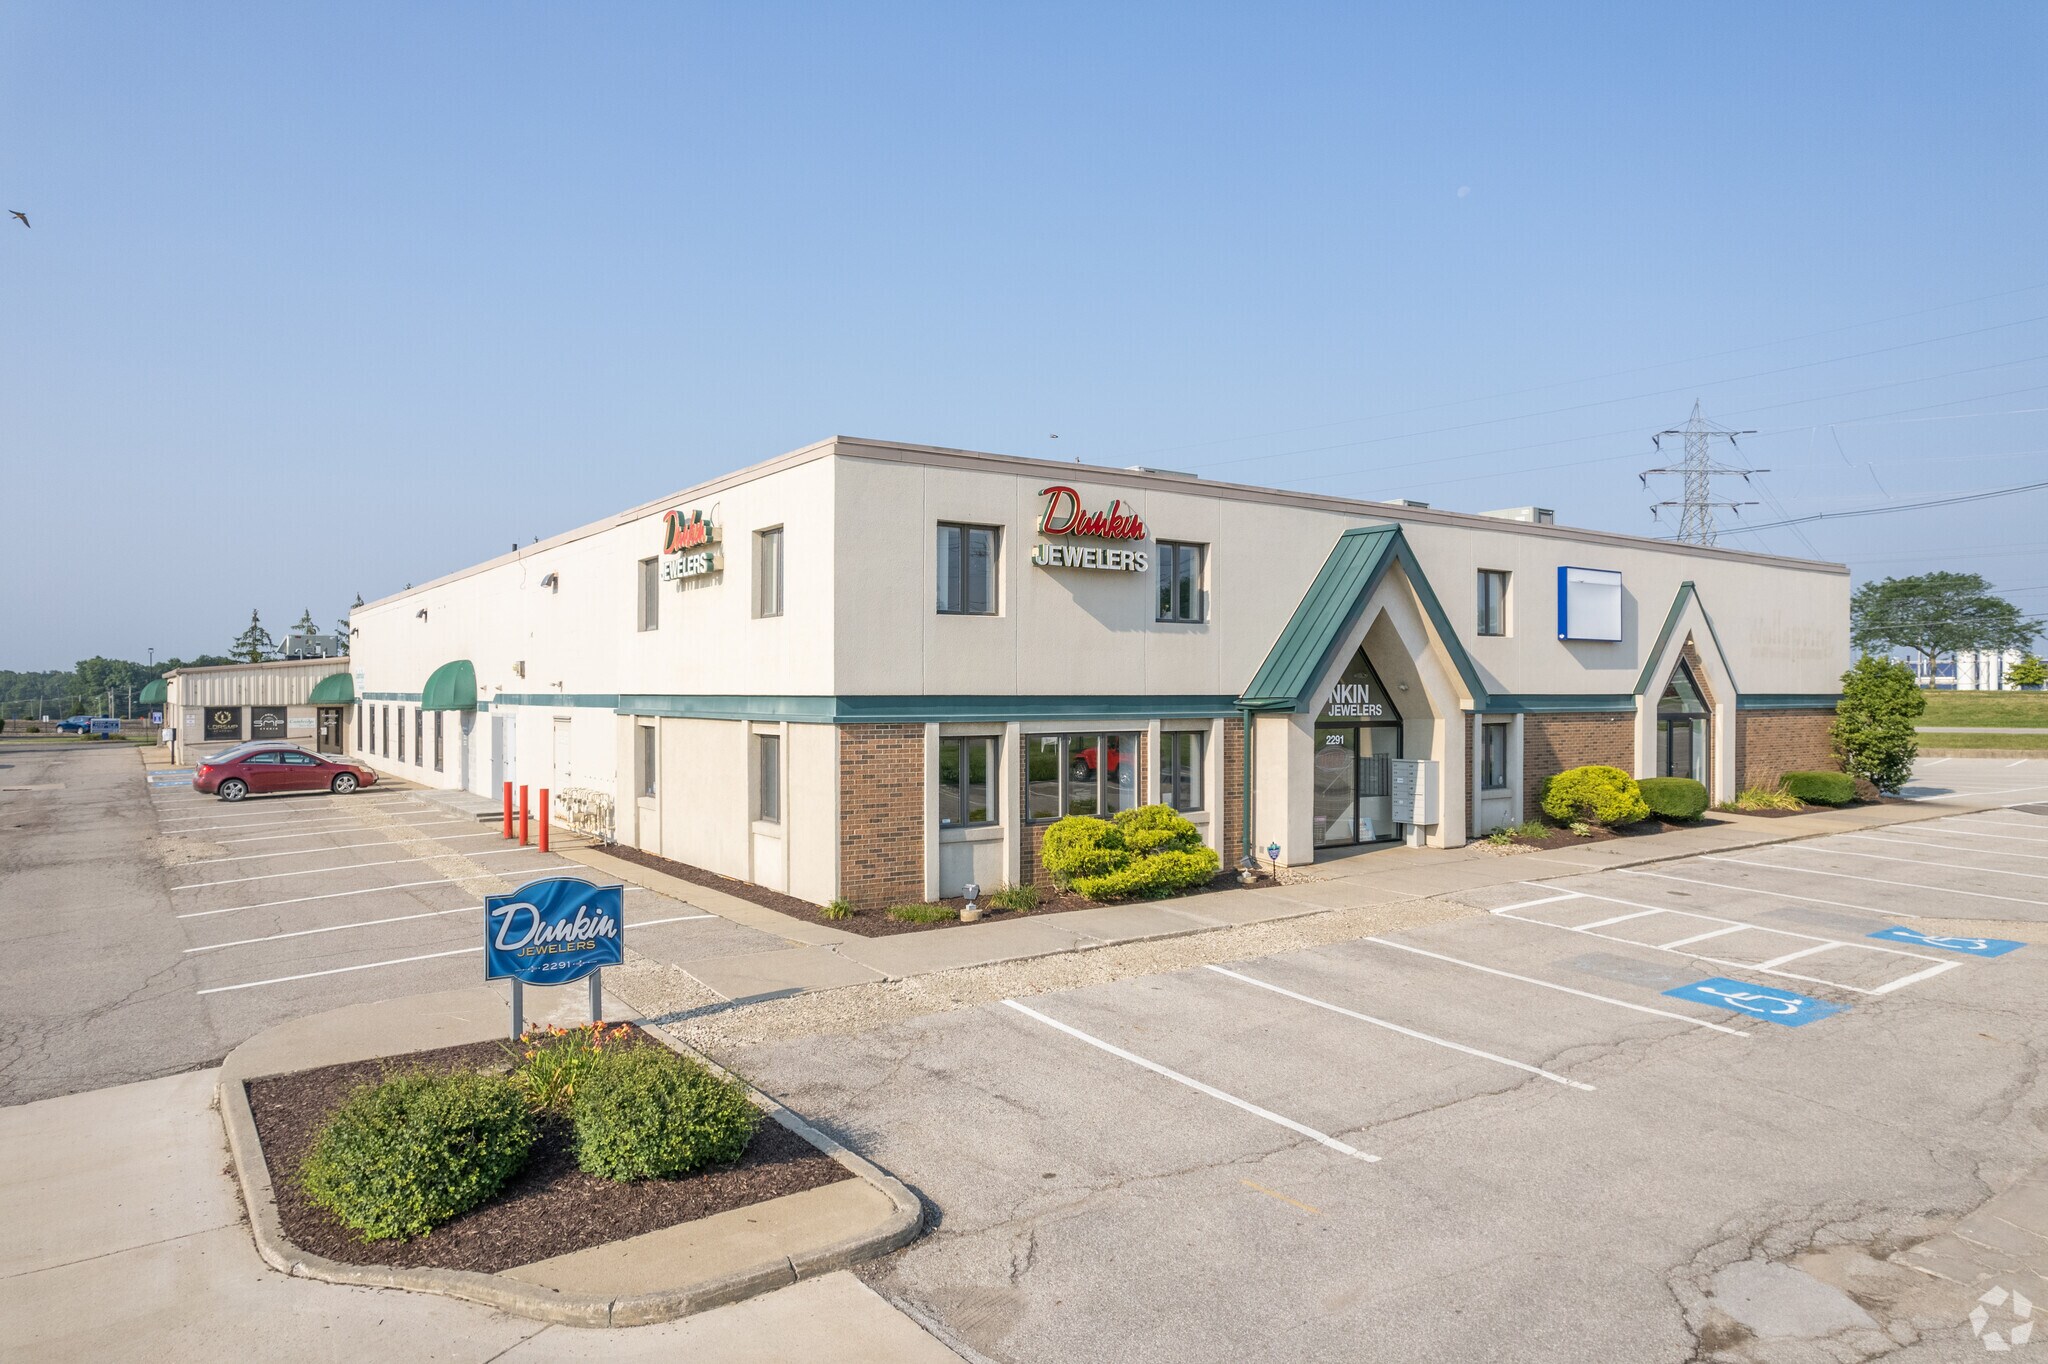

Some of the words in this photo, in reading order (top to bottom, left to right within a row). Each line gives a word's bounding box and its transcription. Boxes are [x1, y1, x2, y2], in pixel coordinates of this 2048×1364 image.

[1040, 486, 1147, 540] Dunkin
[1035, 544, 1148, 572] JEWELERS
[1328, 704, 1382, 716] JEWELERS
[253, 719, 284, 727] SMP
[1326, 735, 1344, 745] 2291
[491, 903, 617, 951] Dunkin
[517, 940, 596, 957] JEWELERS
[542, 961, 571, 971] 2291
